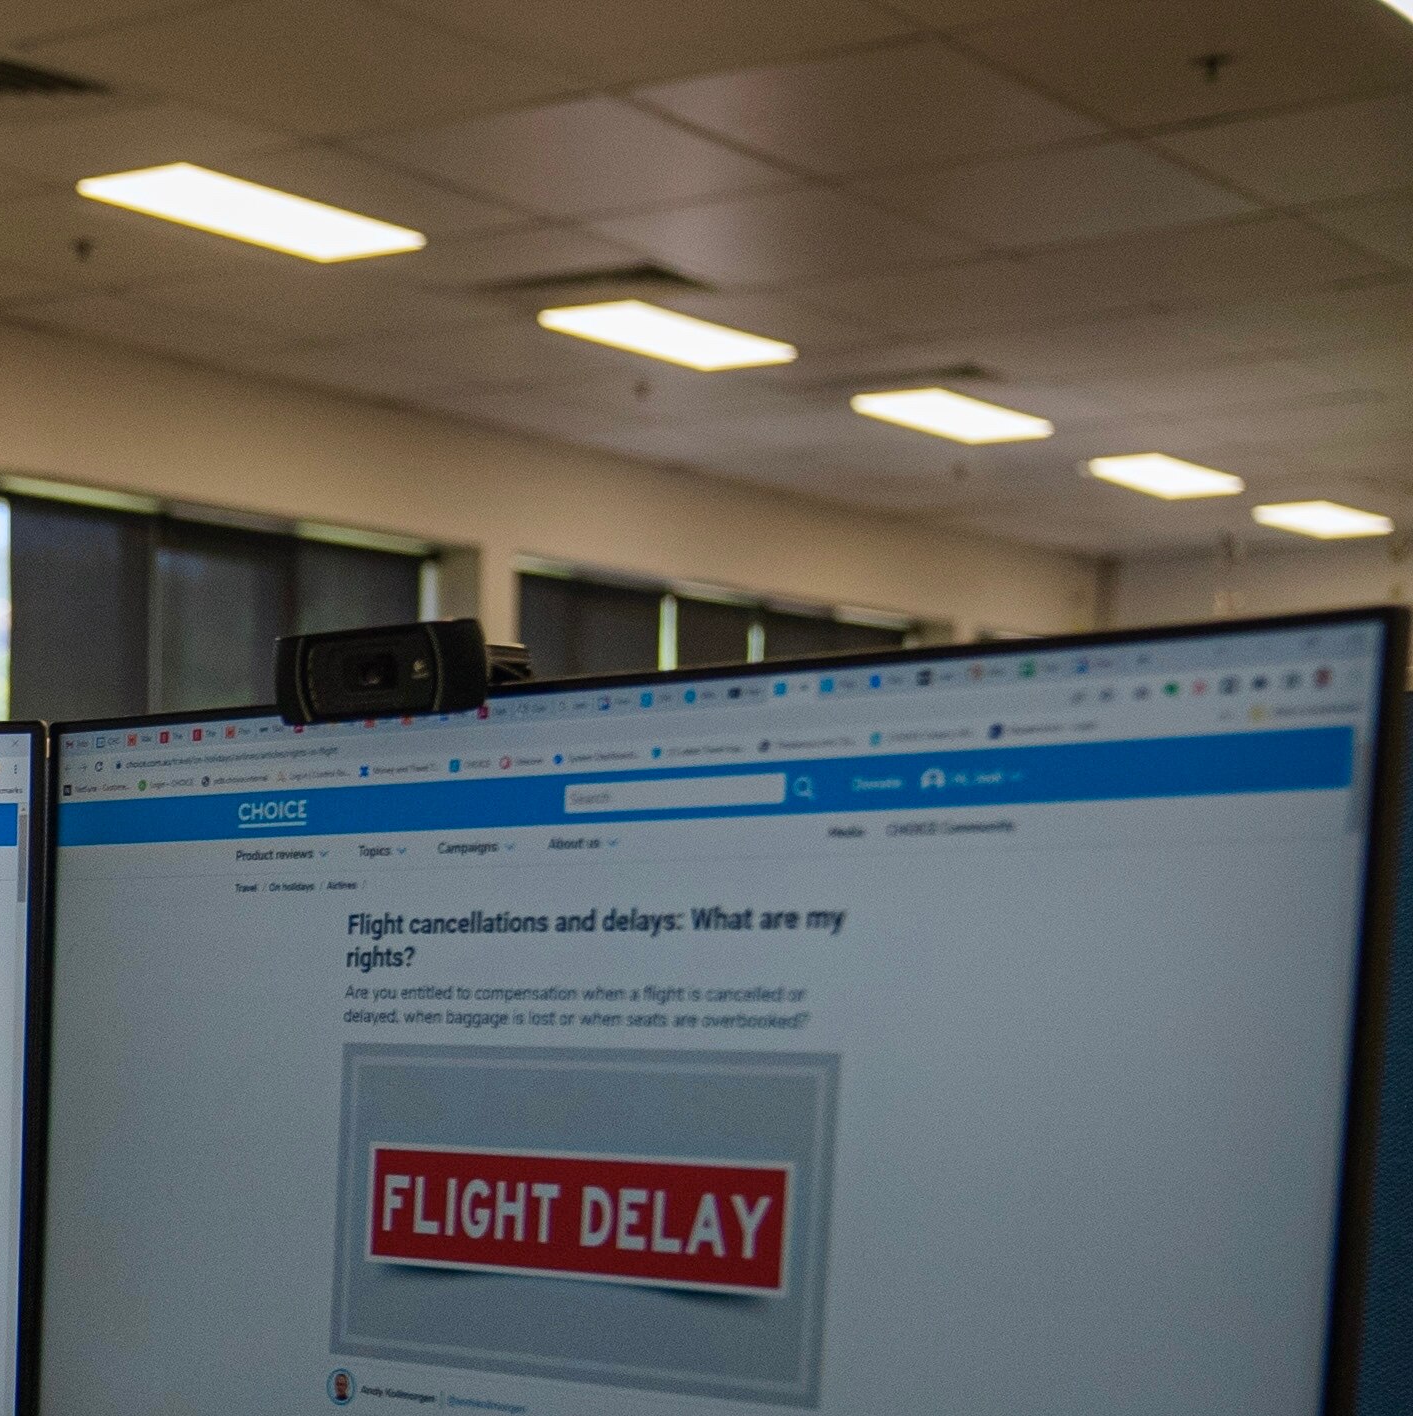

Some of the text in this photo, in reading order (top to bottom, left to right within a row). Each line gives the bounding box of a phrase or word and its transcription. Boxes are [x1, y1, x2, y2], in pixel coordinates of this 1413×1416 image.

[238, 800, 307, 821] CHOICE
[236, 848, 314, 861] Product reviews
[358, 845, 391, 858] Topics
[437, 841, 497, 856] Campaigns
[347, 907, 847, 941] Flight cancellations and delays: What are my
[346, 946, 415, 973] rights?
[456, 987, 470, 1000] to
[403, 1010, 442, 1025] when
[445, 1010, 508, 1028] baggage
[527, 1010, 555, 1026] lost
[580, 1011, 622, 1026] when
[627, 1012, 667, 1027] seats
[381, 1174, 771, 1260] FLIGHT DELAY
